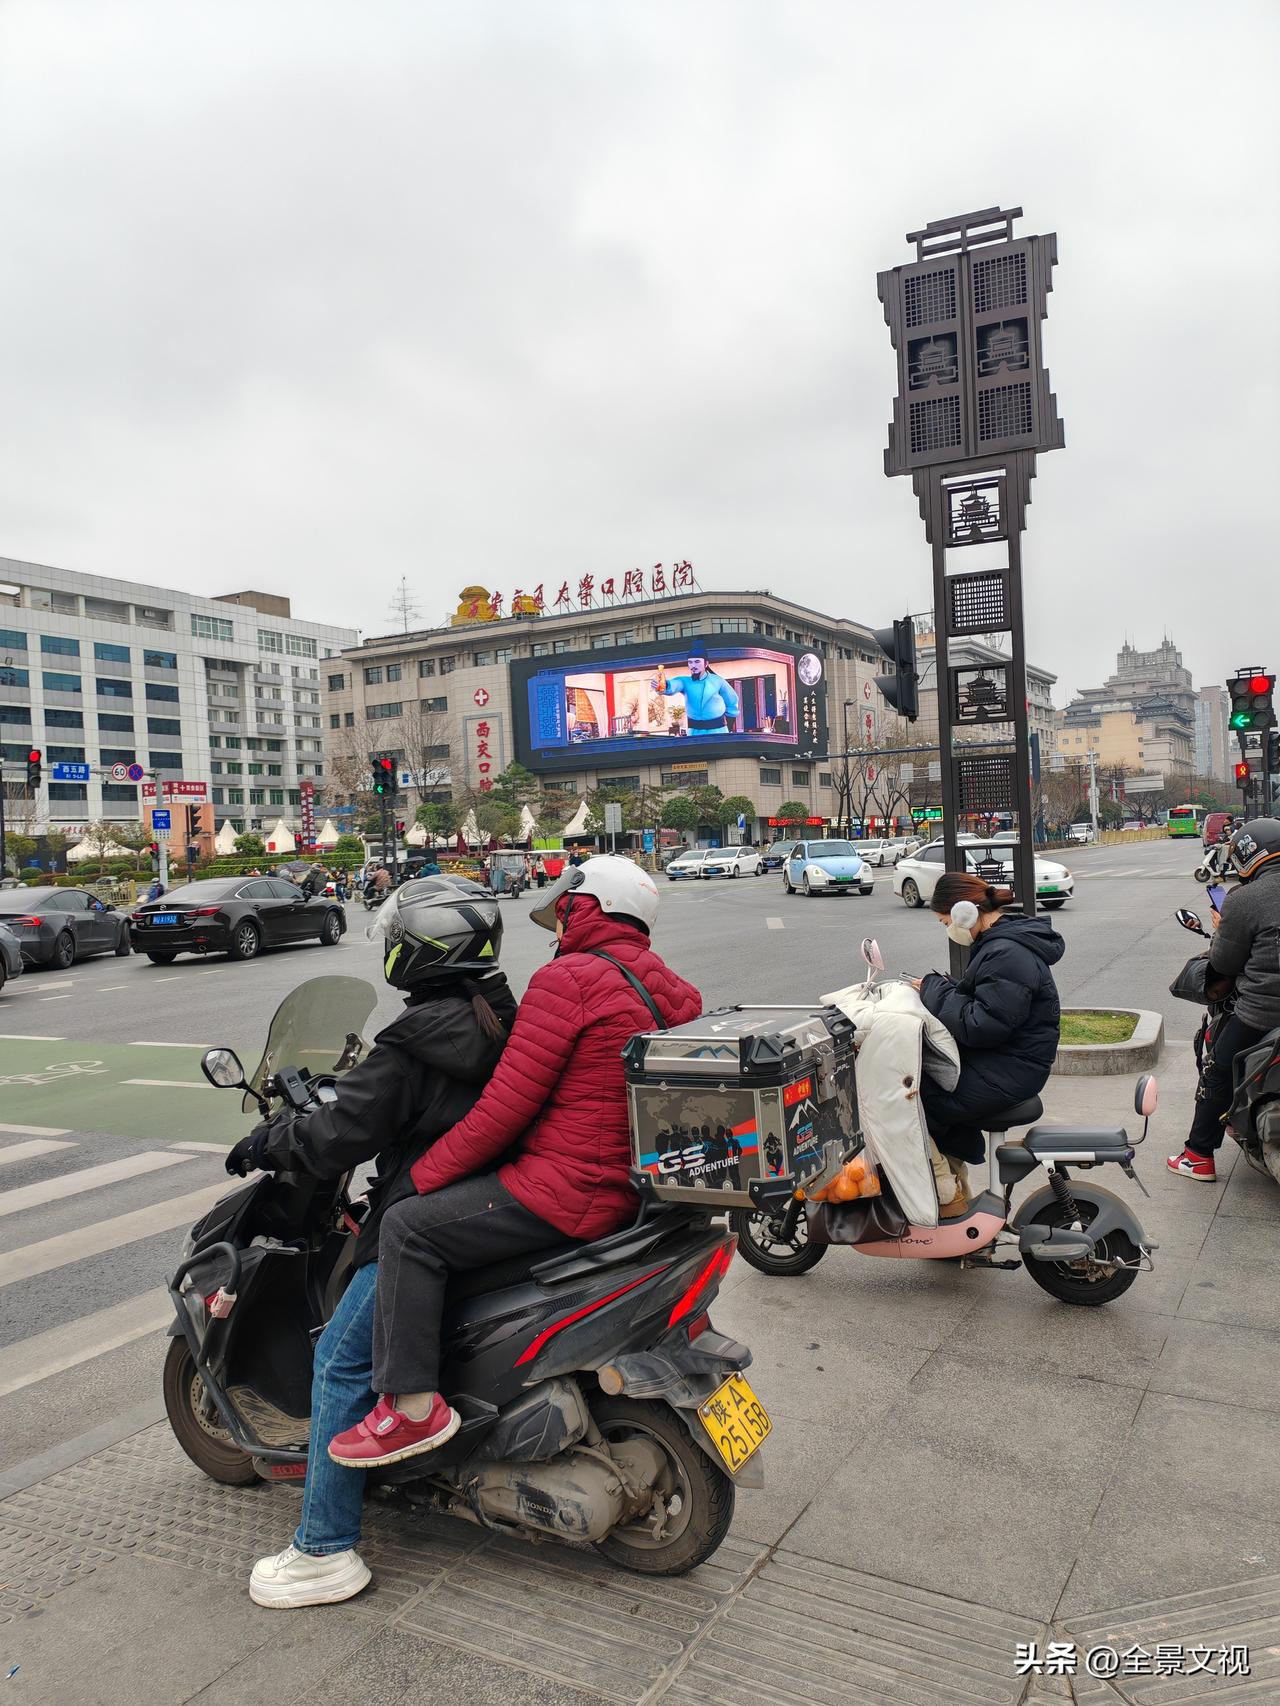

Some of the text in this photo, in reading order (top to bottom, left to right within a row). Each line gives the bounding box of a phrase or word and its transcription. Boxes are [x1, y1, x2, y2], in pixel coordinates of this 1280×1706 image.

[466, 559, 694, 618] 西安交通大学口腔医院
[62, 765, 86, 774] 西五路
[114, 768, 125, 777] 60
[657, 1144, 706, 1174] GS
[689, 1155, 740, 1177] ADVENTURE
[720, 1402, 769, 1467] 2515B
